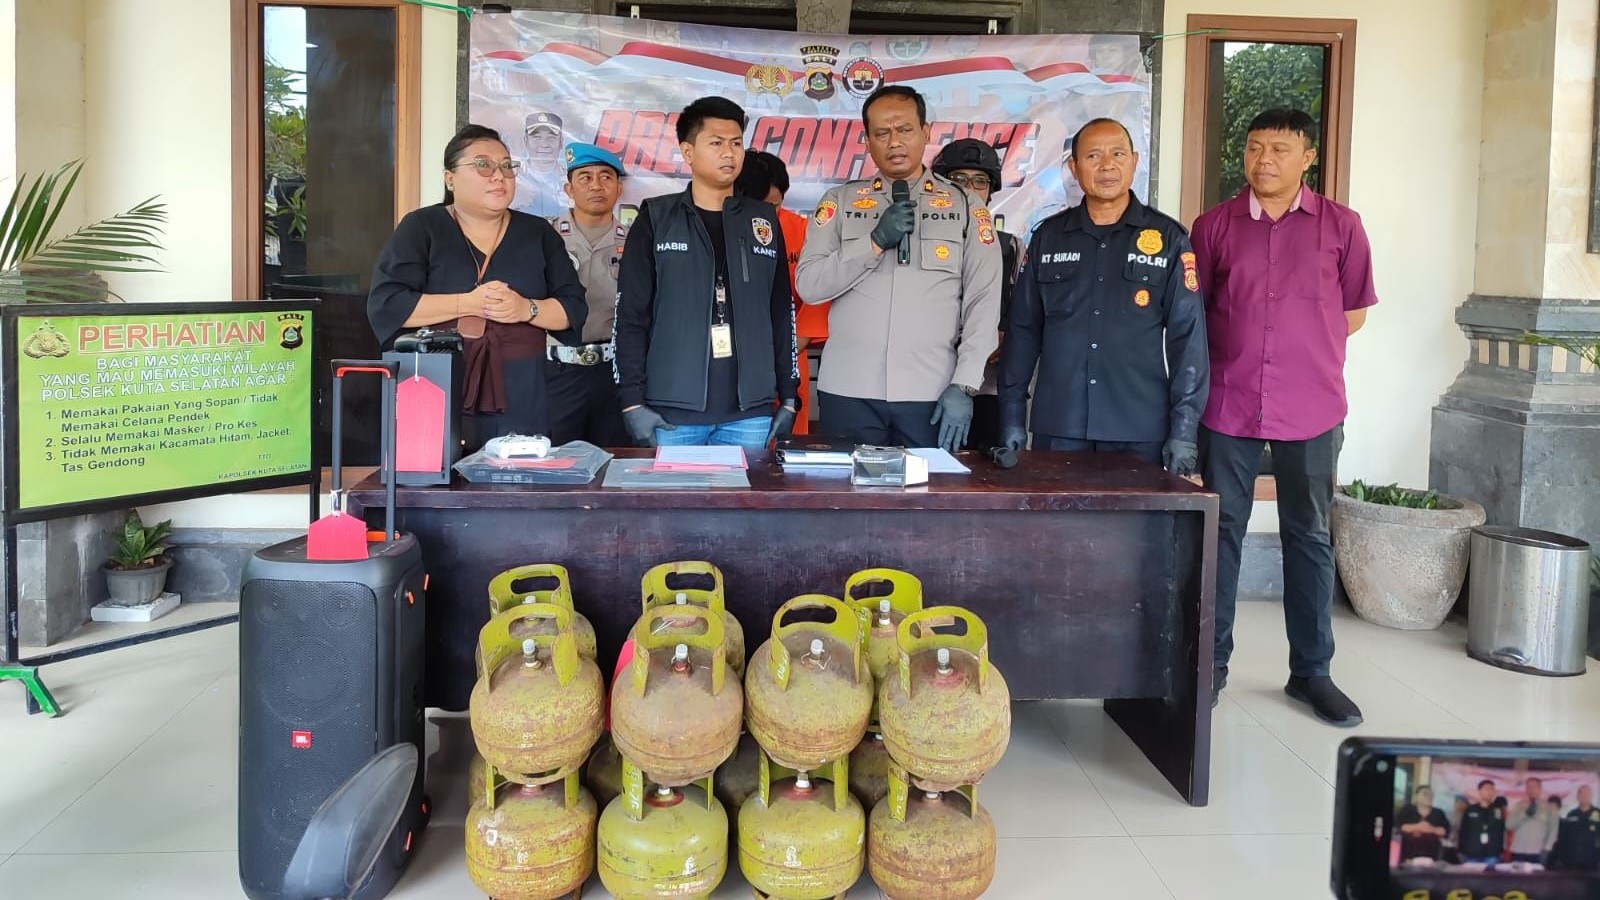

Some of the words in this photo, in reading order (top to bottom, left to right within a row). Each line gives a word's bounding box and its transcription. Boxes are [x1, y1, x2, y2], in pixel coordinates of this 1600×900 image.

[594, 110, 694, 177] PRE
[845, 211, 868, 219] TRI
[922, 212, 961, 221] POLRI
[656, 242, 688, 252] HABIB
[1041, 253, 1051, 264] KT
[1053, 252, 1081, 263] SUKADI
[1127, 253, 1167, 268] POLRI
[79, 320, 266, 351] PERHATIAN
[96, 356, 138, 370] BAGI
[144, 350, 251, 367] MASYARAKAT
[40, 373, 90, 387] YANG
[97, 371, 134, 384] MAU
[141, 365, 226, 381] MEMASUKI
[231, 360, 295, 375] WILAYAH
[42, 385, 115, 401] POLSEK
[121, 381, 165, 396] KUTA
[170, 377, 240, 393] SELATAN
[245, 374, 287, 387] AGAR
[46, 411, 56, 420] 1.
[61, 407, 118, 419] Memakai
[122, 403, 170, 414] Pakaian
[174, 400, 202, 411] Yang
[205, 397, 240, 407] Sopan
[250, 393, 278, 403] Tidak
[61, 420, 118, 433] Memakai
[122, 416, 164, 427] Celana
[167, 412, 210, 423] Pendek
[45, 438, 56, 448] 2.
[61, 435, 101, 446] Selalu
[105, 430, 160, 442] Memakai
[163, 425, 205, 437] Masker
[215, 422, 234, 431] Pro
[237, 420, 257, 429] Kes
[45, 451, 56, 461] 3.
[61, 447, 96, 459] Tidak
[101, 443, 155, 455] Memakai
[159, 436, 216, 450] Kacamata
[61, 463, 83, 473] Tas
[88, 457, 145, 470] Gendong
